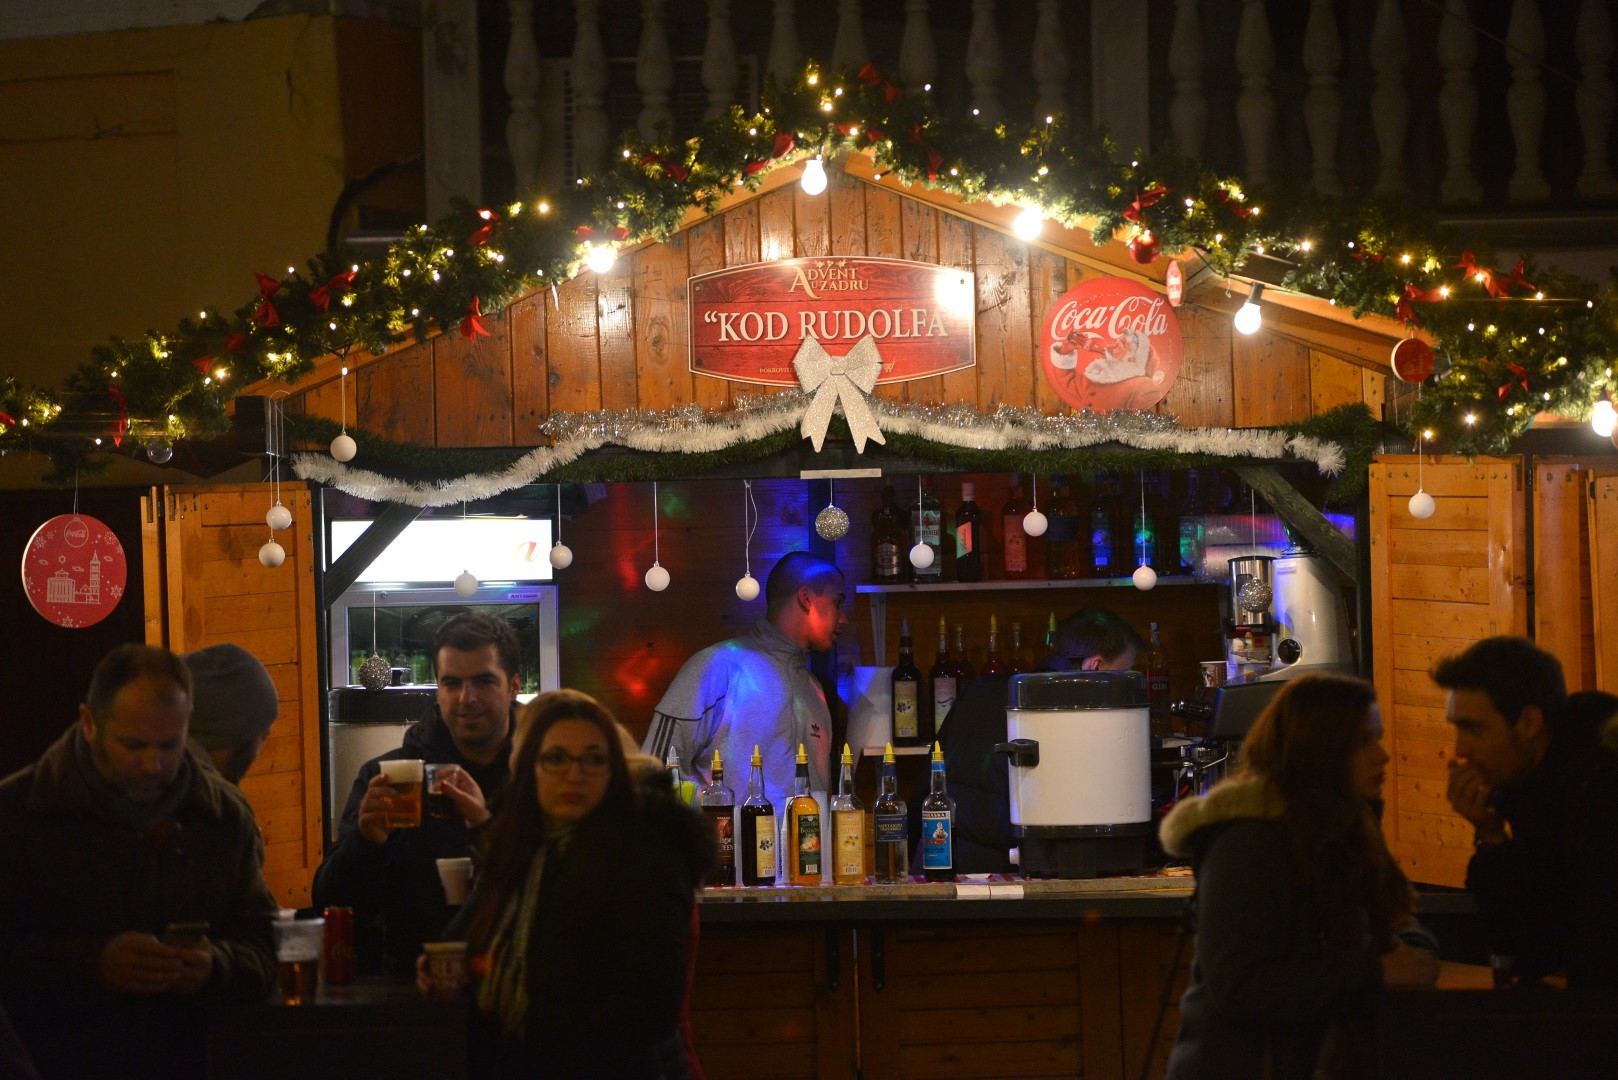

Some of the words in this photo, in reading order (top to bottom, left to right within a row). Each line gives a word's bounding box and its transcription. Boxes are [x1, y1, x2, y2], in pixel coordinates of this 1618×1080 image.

[788, 266, 858, 299] ADVENT
[820, 280, 869, 291] ZADRU
[1051, 296, 1169, 341] Coca-Cola
